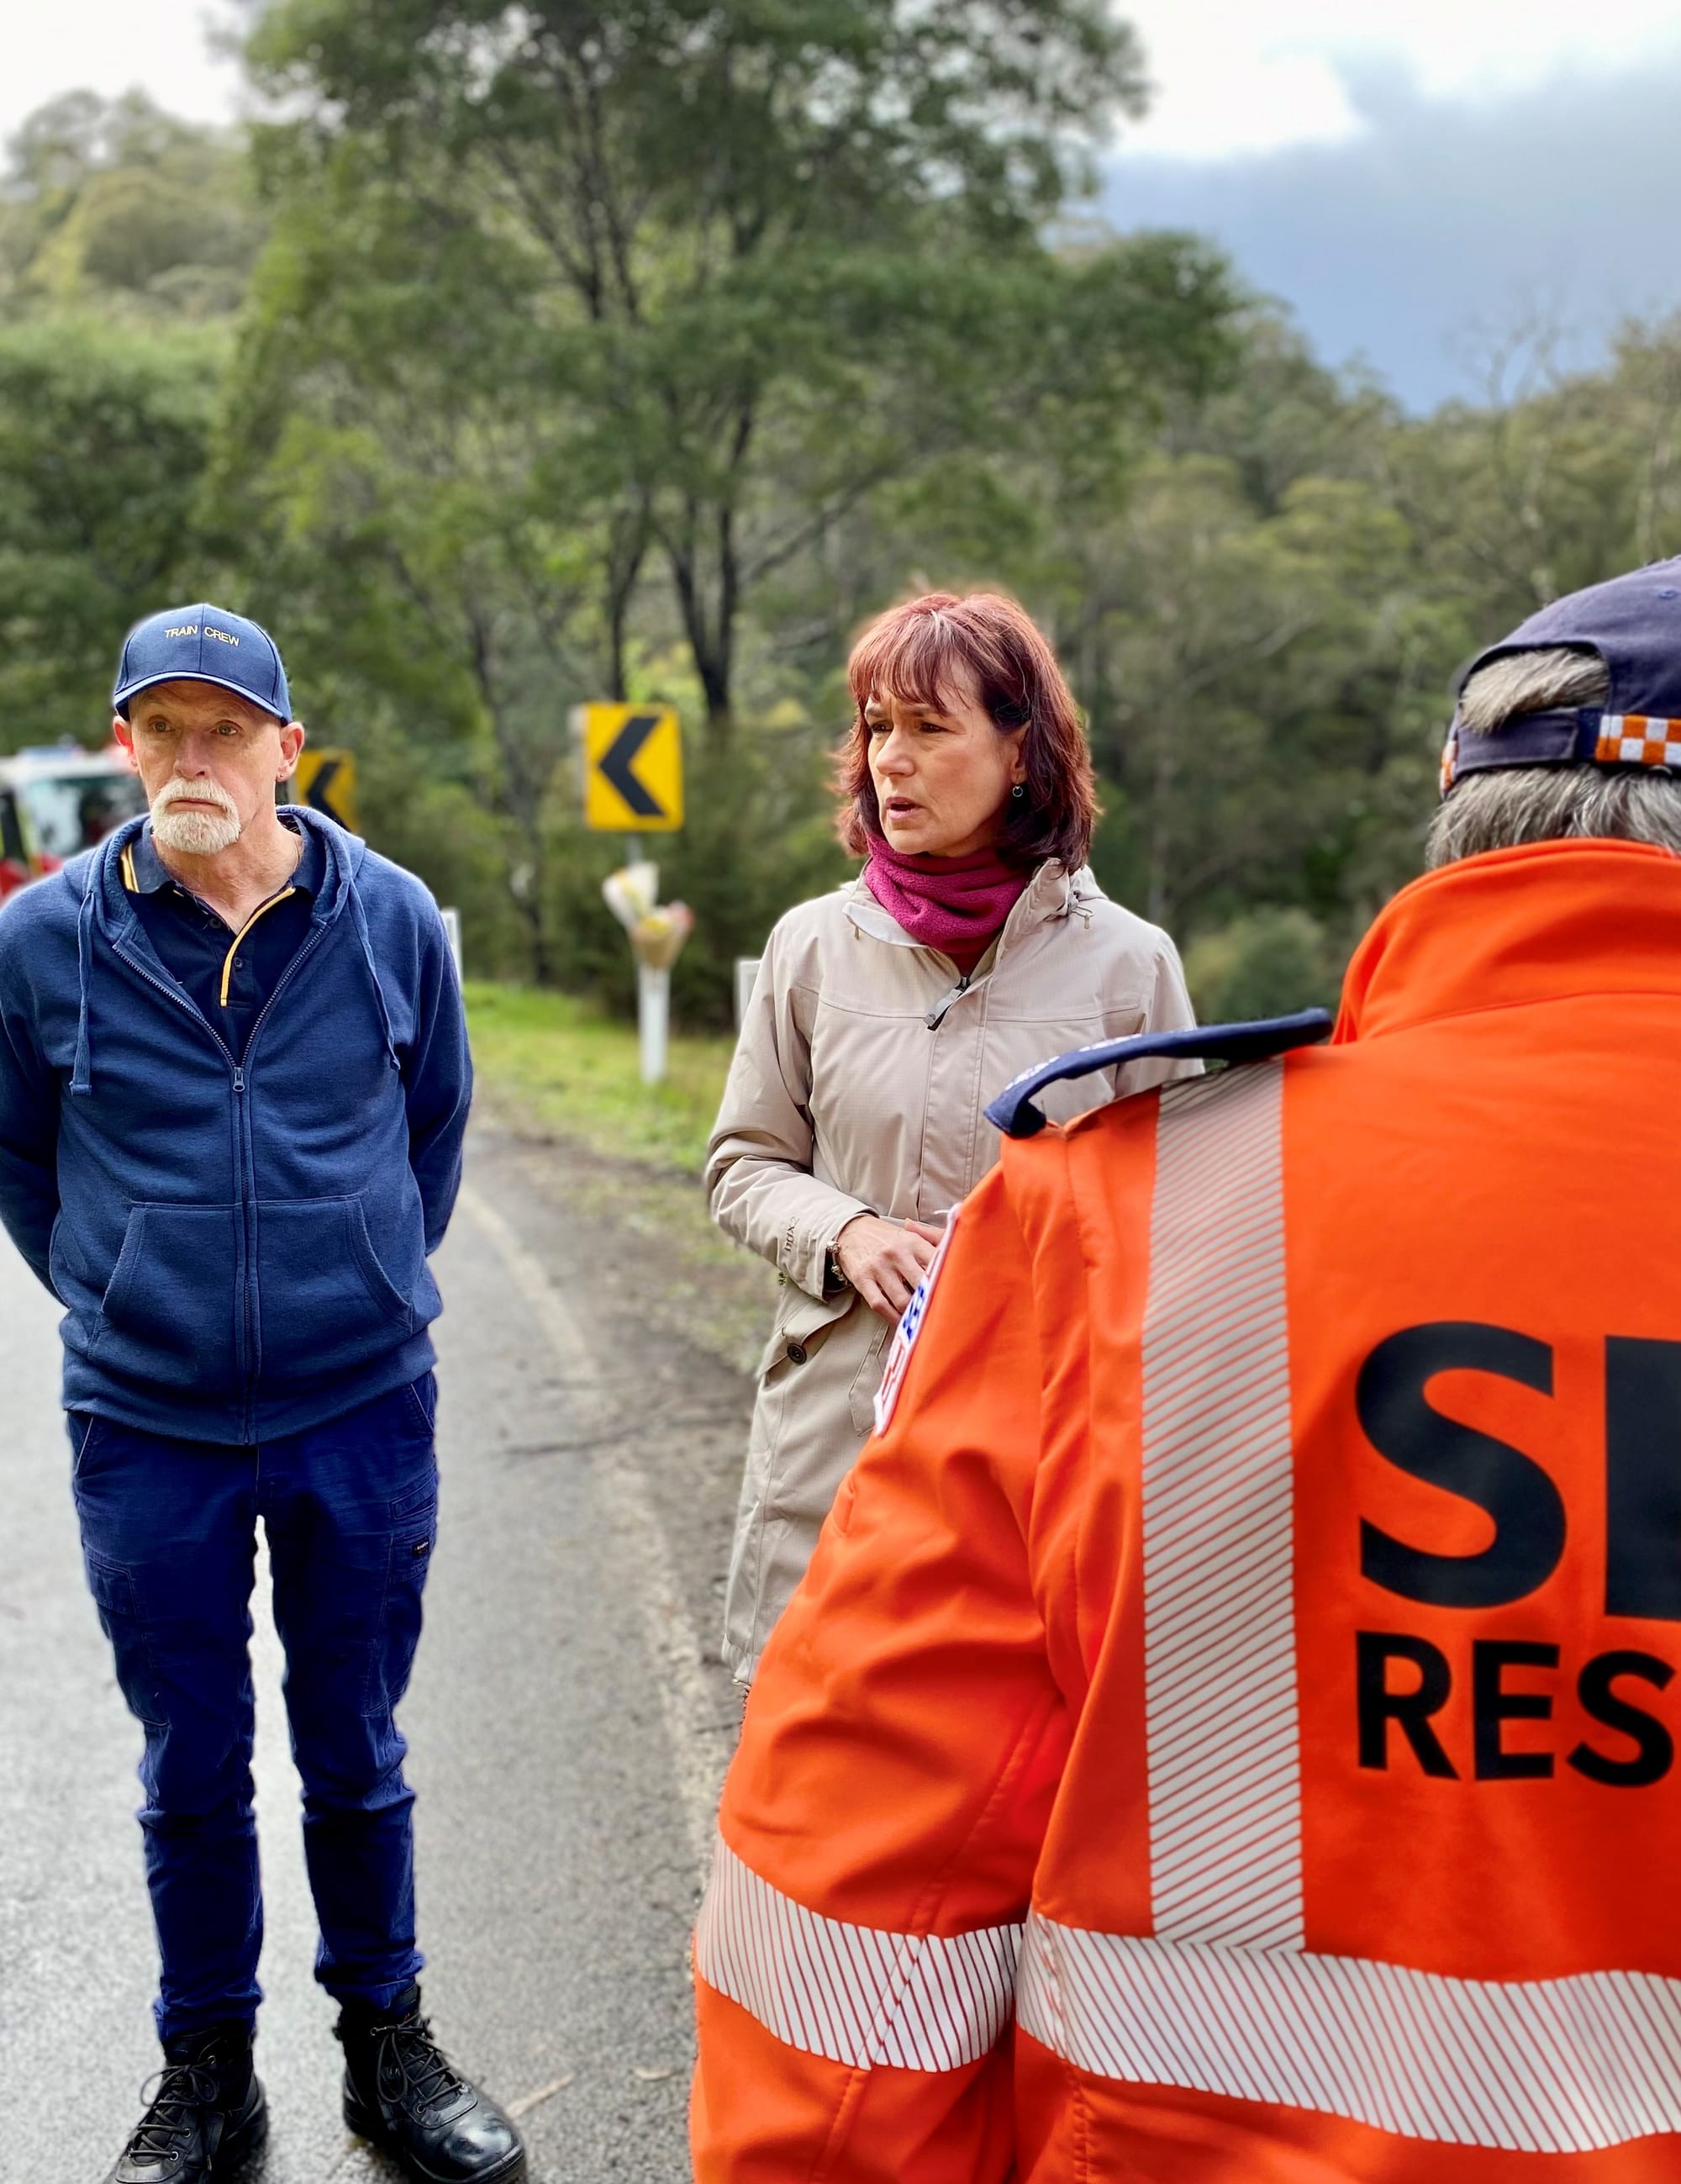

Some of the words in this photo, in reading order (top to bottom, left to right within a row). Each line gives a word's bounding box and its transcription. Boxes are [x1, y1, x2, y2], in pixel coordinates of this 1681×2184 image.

[164, 625, 198, 638] TRAIN
[203, 626, 240, 646] CREW
[1356, 1629, 1676, 1788] RES
